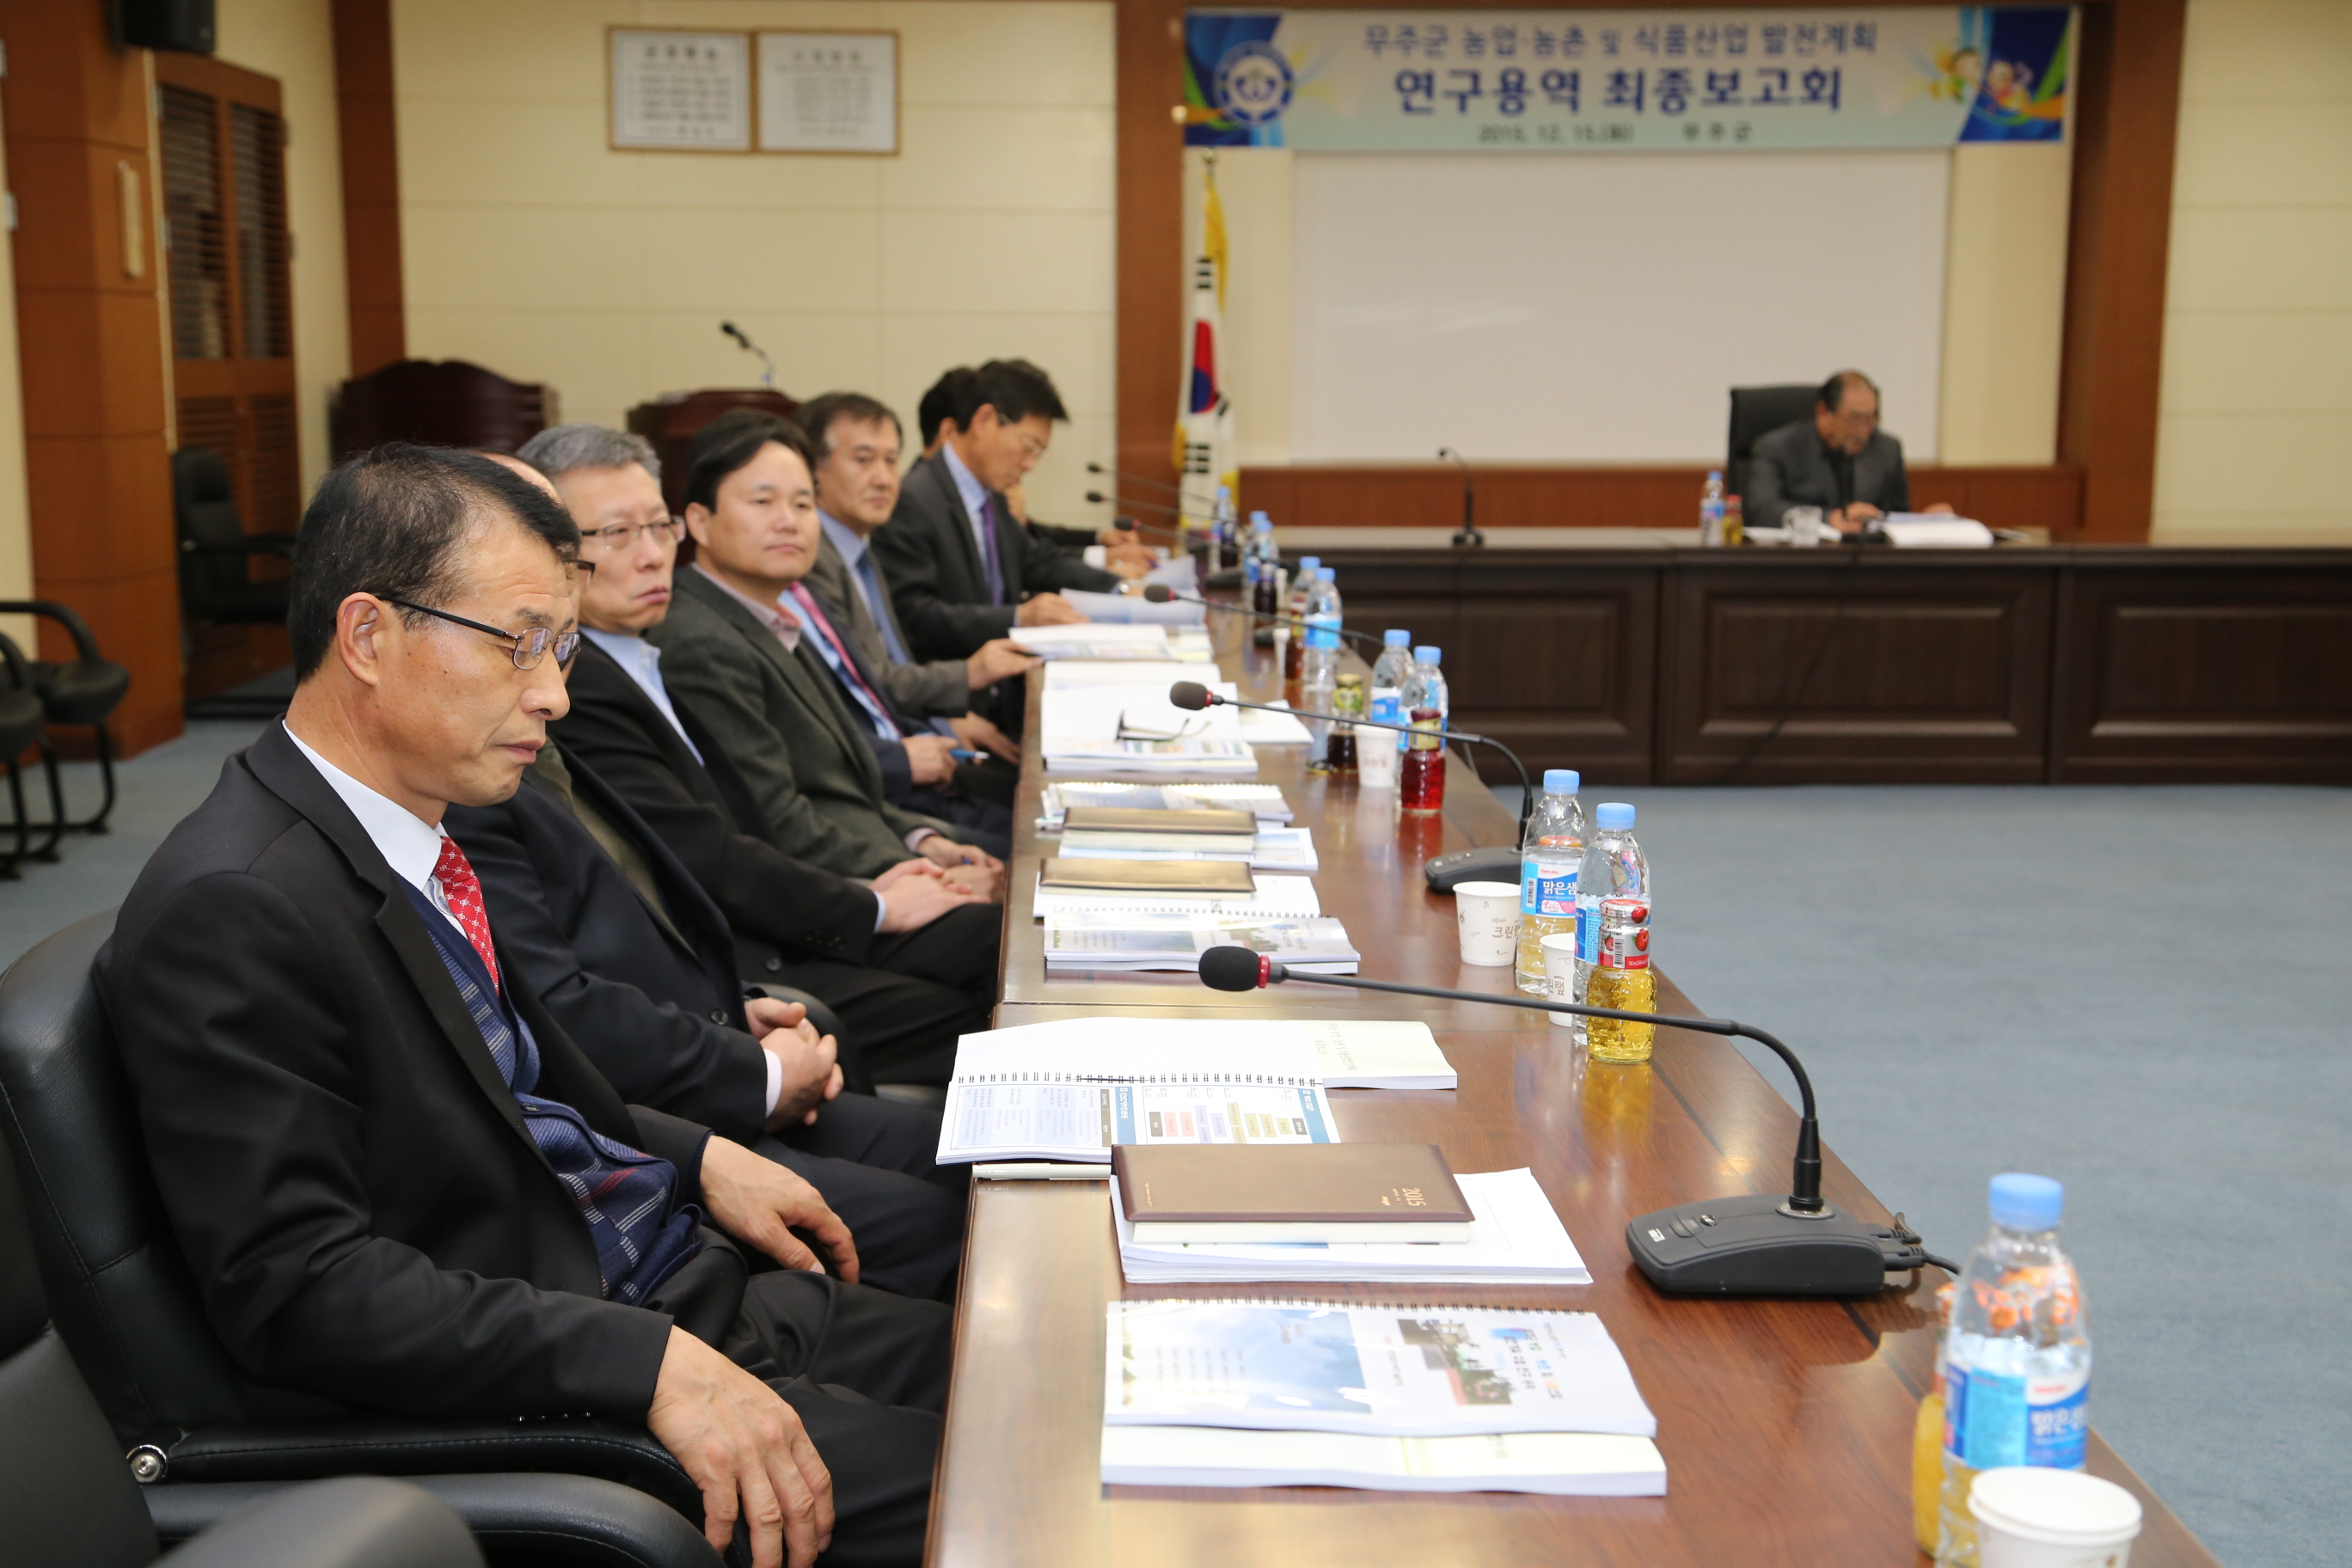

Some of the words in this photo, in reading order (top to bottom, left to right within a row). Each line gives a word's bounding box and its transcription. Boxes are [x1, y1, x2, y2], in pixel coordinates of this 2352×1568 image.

[1365, 24, 1449, 59] 무주군
[1601, 28, 1622, 58] 및
[1635, 23, 1749, 58] 식품산업
[1761, 21, 1877, 58] 발전계획
[1394, 67, 1581, 116] 연구용역
[1602, 64, 1840, 114] 최종보고회
[1542, 881, 1577, 895] 맑은샘
[1400, 1187, 1428, 1207] 2015
